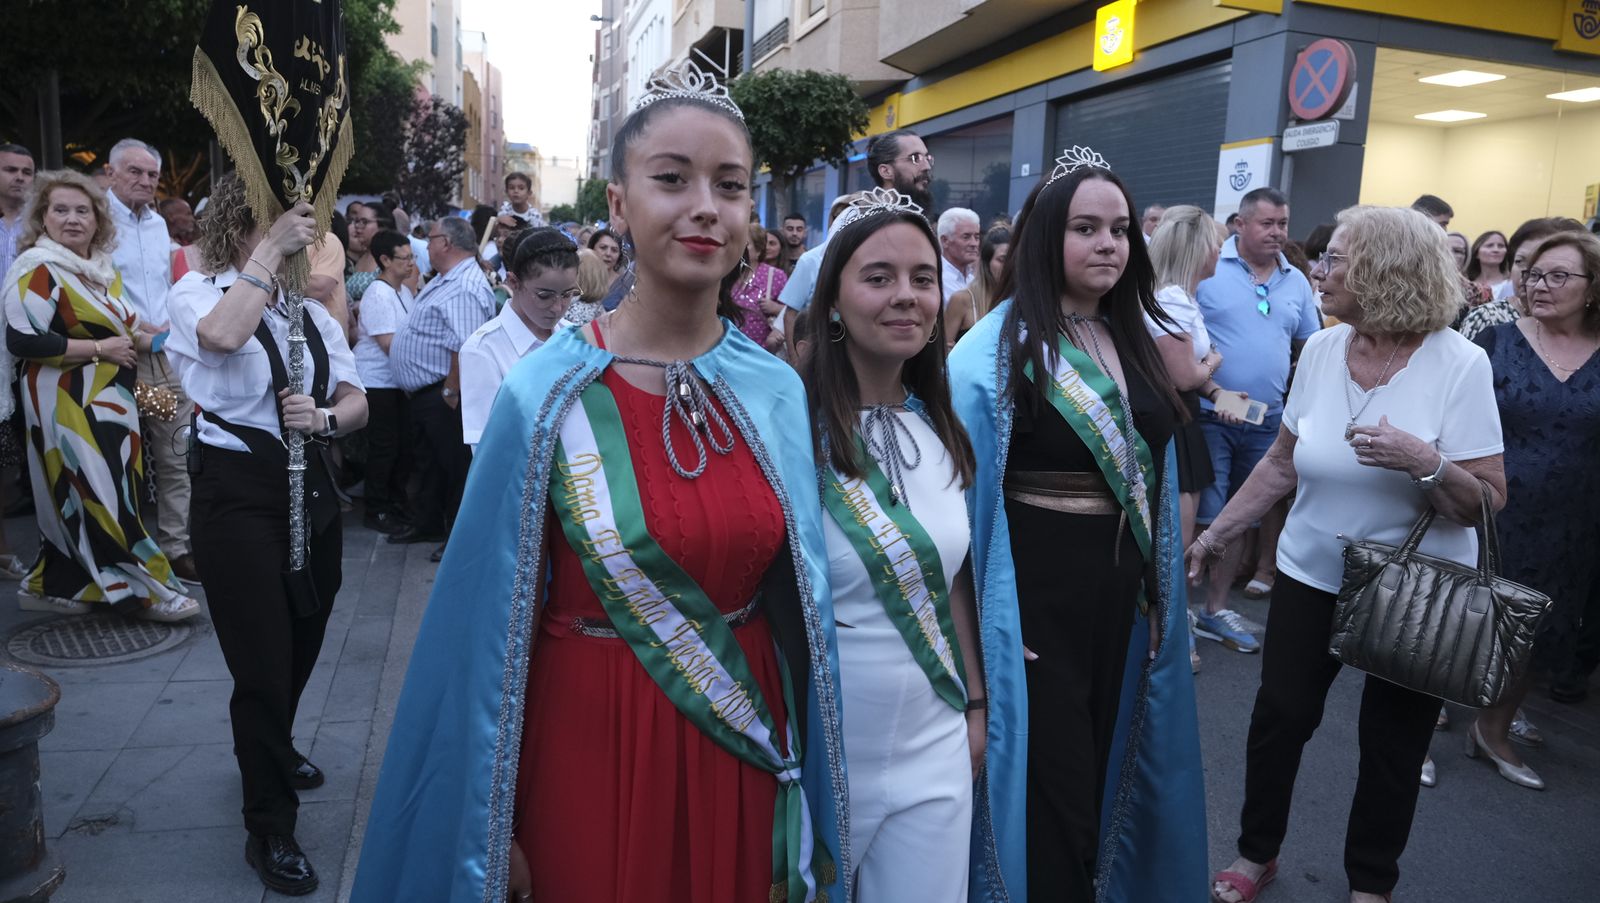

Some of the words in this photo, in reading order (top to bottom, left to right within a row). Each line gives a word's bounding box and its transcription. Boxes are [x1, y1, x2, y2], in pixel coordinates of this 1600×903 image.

[1285, 129, 1301, 138] SALIDA
[1303, 124, 1336, 136] EMERGENCIA
[1054, 369, 1096, 415] Dama
[556, 453, 603, 526] Dama
[833, 478, 879, 527] Dama
[582, 529, 634, 564] El
[868, 521, 912, 555] El
[602, 567, 681, 626] Ejido
[882, 550, 934, 601] Ejido
[651, 619, 721, 694] Fiestas
